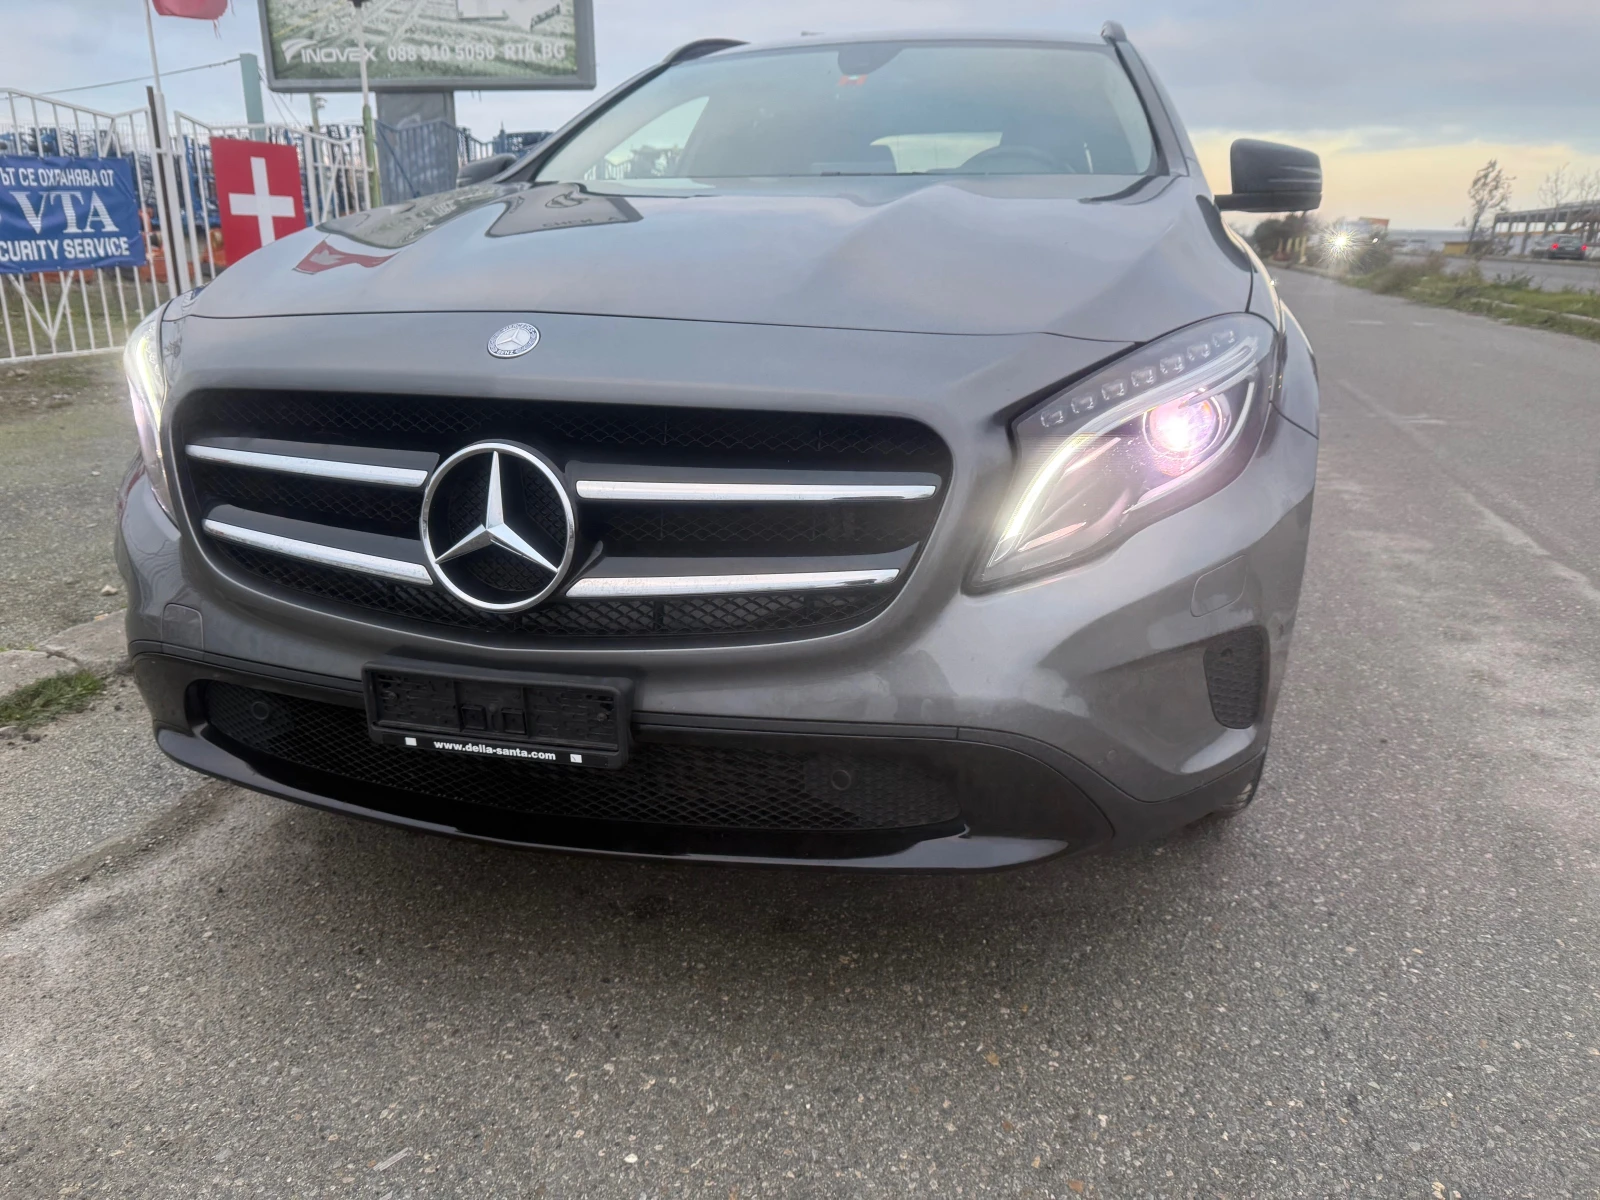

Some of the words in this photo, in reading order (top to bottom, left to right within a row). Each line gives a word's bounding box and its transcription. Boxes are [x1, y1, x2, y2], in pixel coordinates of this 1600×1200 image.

[301, 46, 377, 63] INOVEX
[387, 43, 417, 62] 088
[455, 43, 495, 60] 5050
[18, 168, 38, 186] СЕ
[38, 168, 100, 187] ОХРАНЯВА
[100, 169, 114, 187] ОТ
[9, 190, 120, 234] VTA
[62, 237, 130, 259] SERVICE
[433, 741, 556, 760] www.della-santa.com
